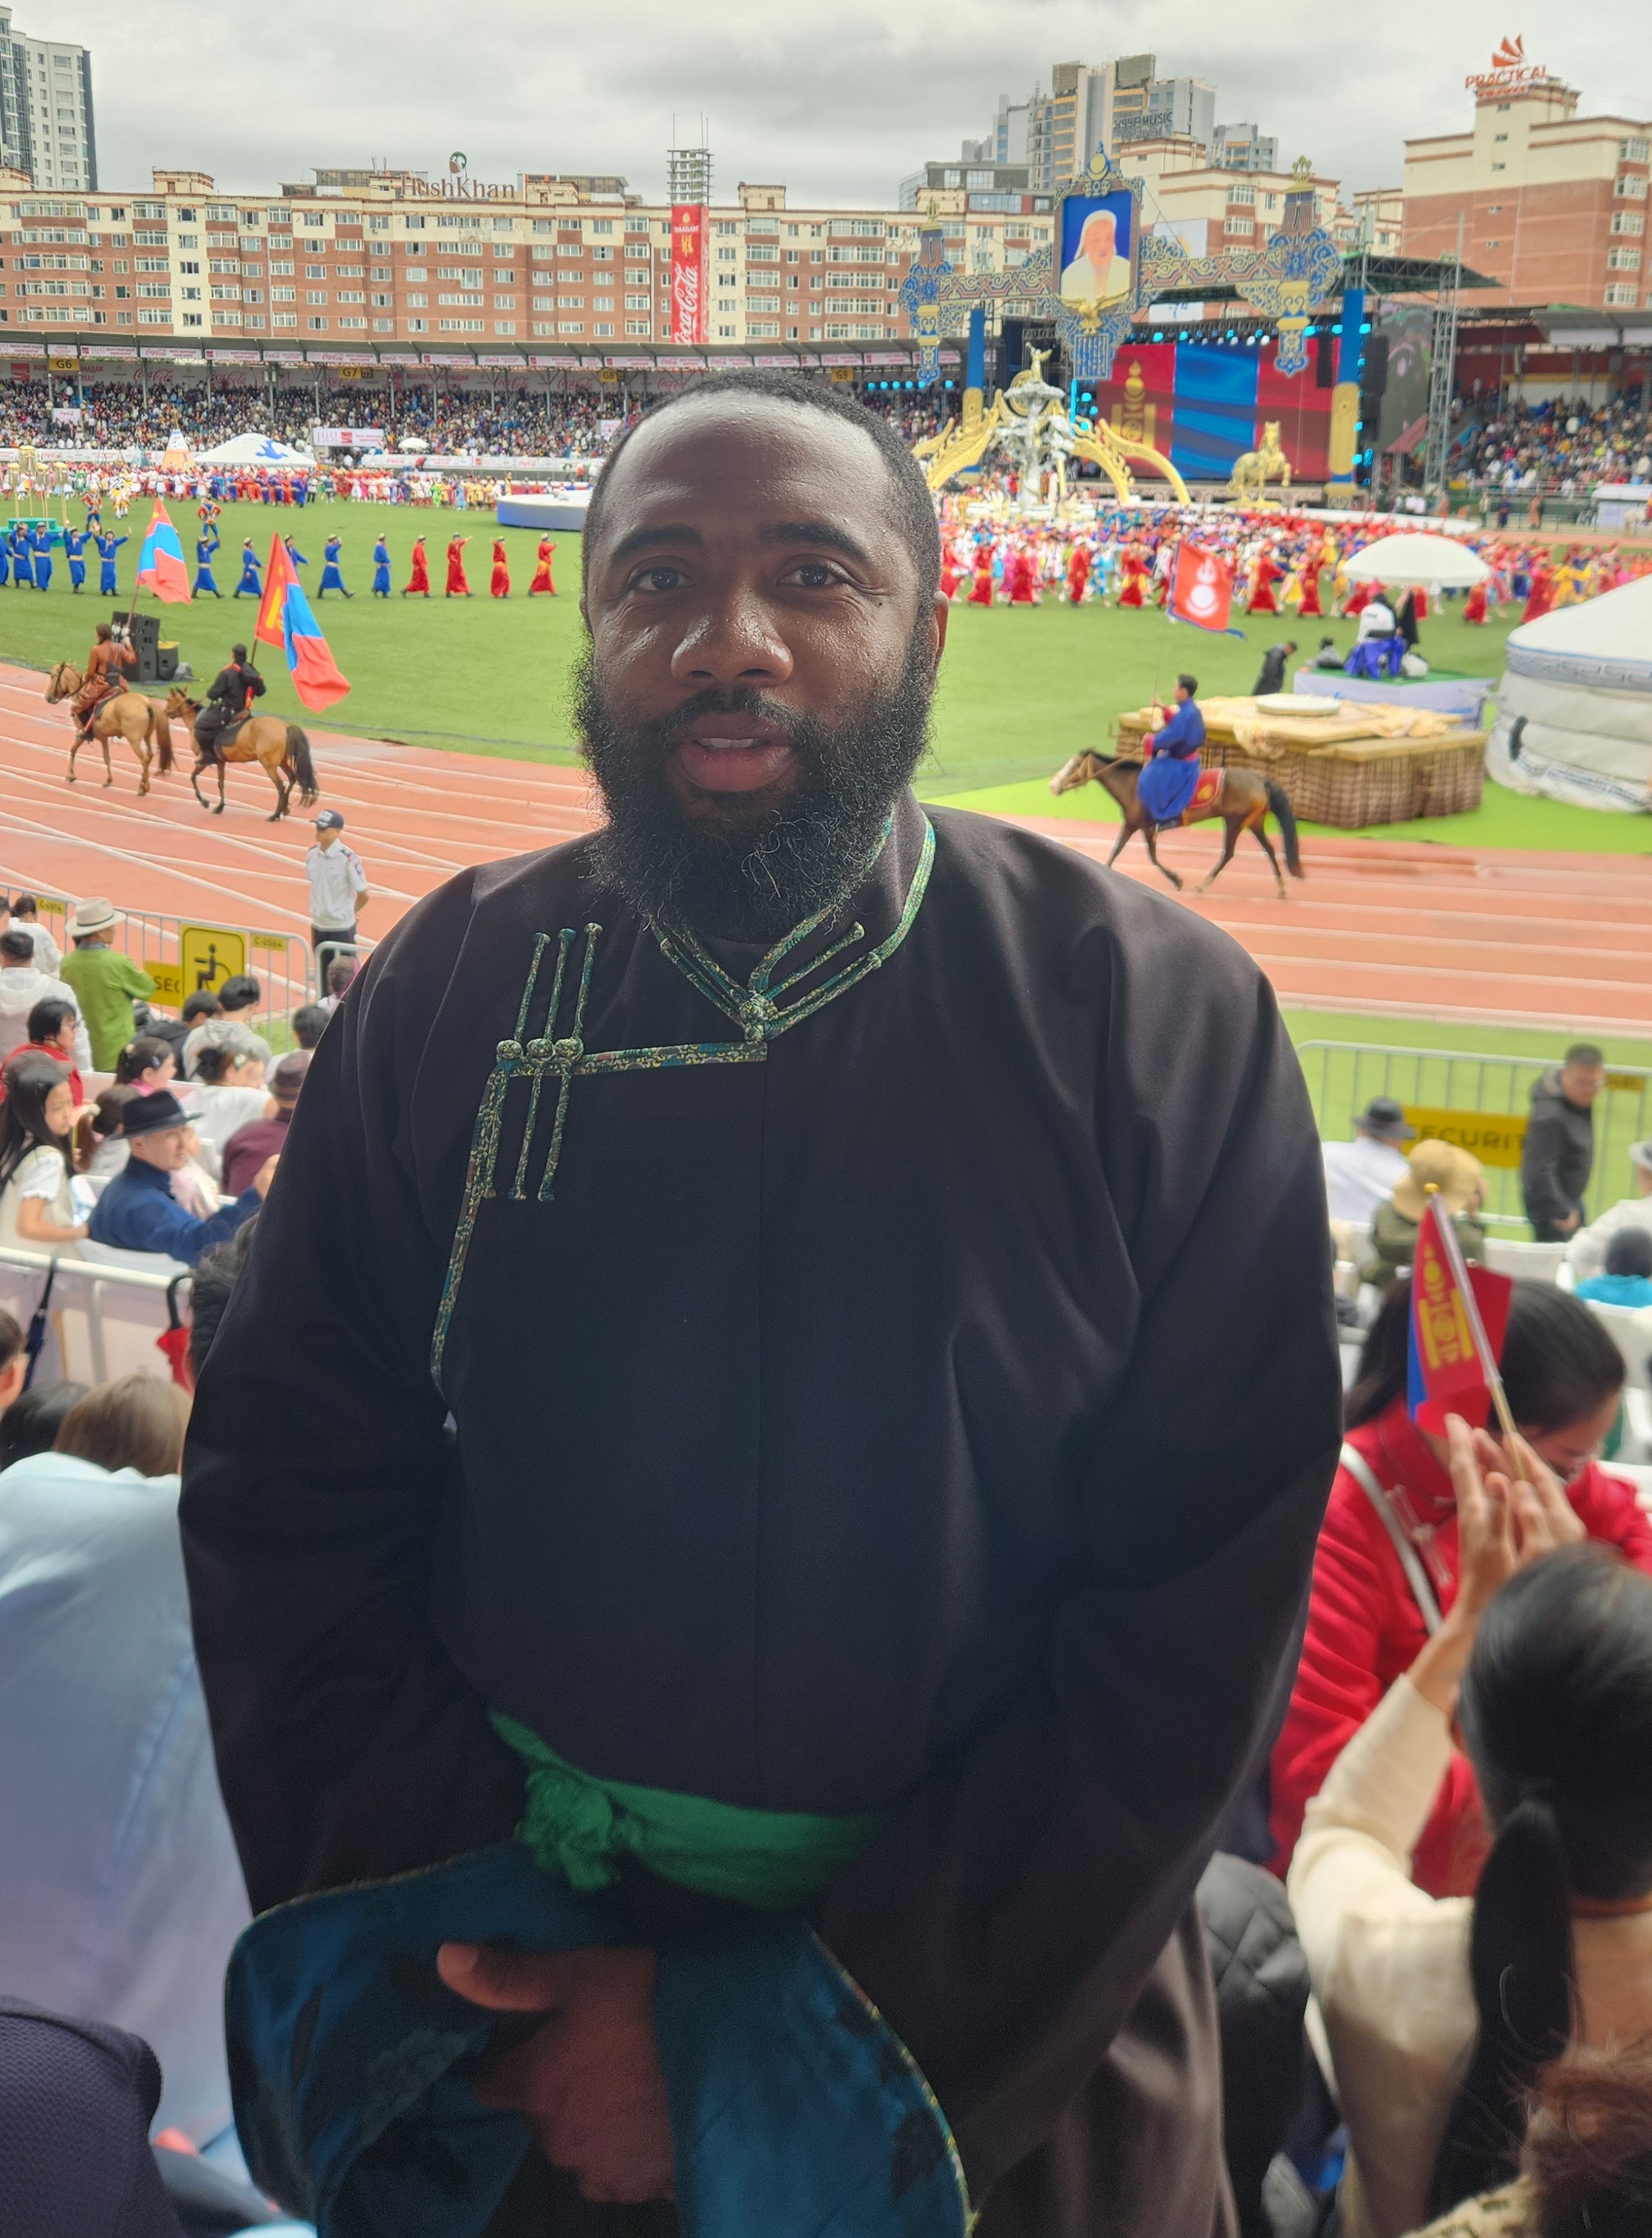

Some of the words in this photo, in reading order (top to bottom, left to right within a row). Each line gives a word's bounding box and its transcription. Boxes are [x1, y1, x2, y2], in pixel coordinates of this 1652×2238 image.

[56, 360, 72, 369] G6
[343, 368, 358, 377] G7
[603, 372, 615, 380] G8
[836, 369, 847, 380] G9
